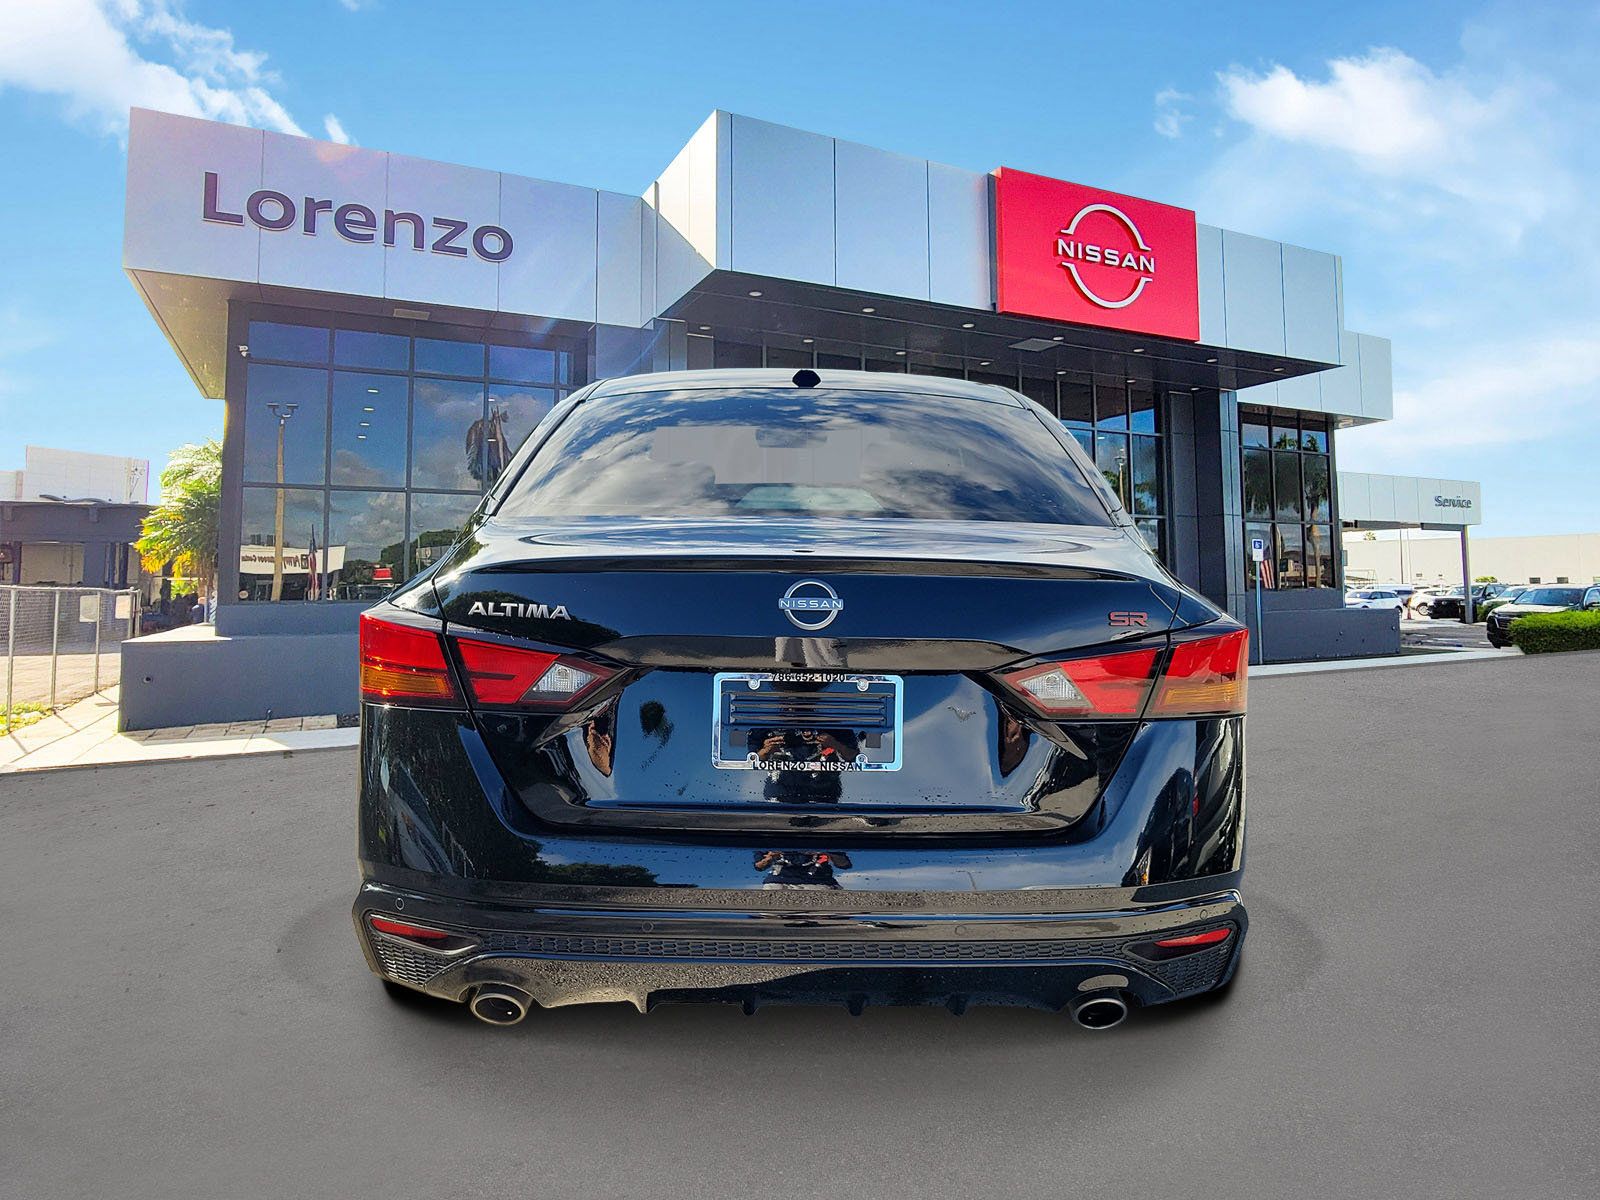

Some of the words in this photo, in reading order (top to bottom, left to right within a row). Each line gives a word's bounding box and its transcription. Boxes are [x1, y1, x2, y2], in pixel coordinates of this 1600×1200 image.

[203, 171, 514, 262] Lorenzo
[1057, 238, 1155, 273] NISSAN
[1434, 495, 1472, 509] Service
[468, 601, 572, 620] ALTIMA
[780, 600, 842, 608] NISSAN
[1109, 611, 1149, 626] SR
[752, 761, 806, 771] LORENZO
[820, 761, 863, 772] NISSAN
